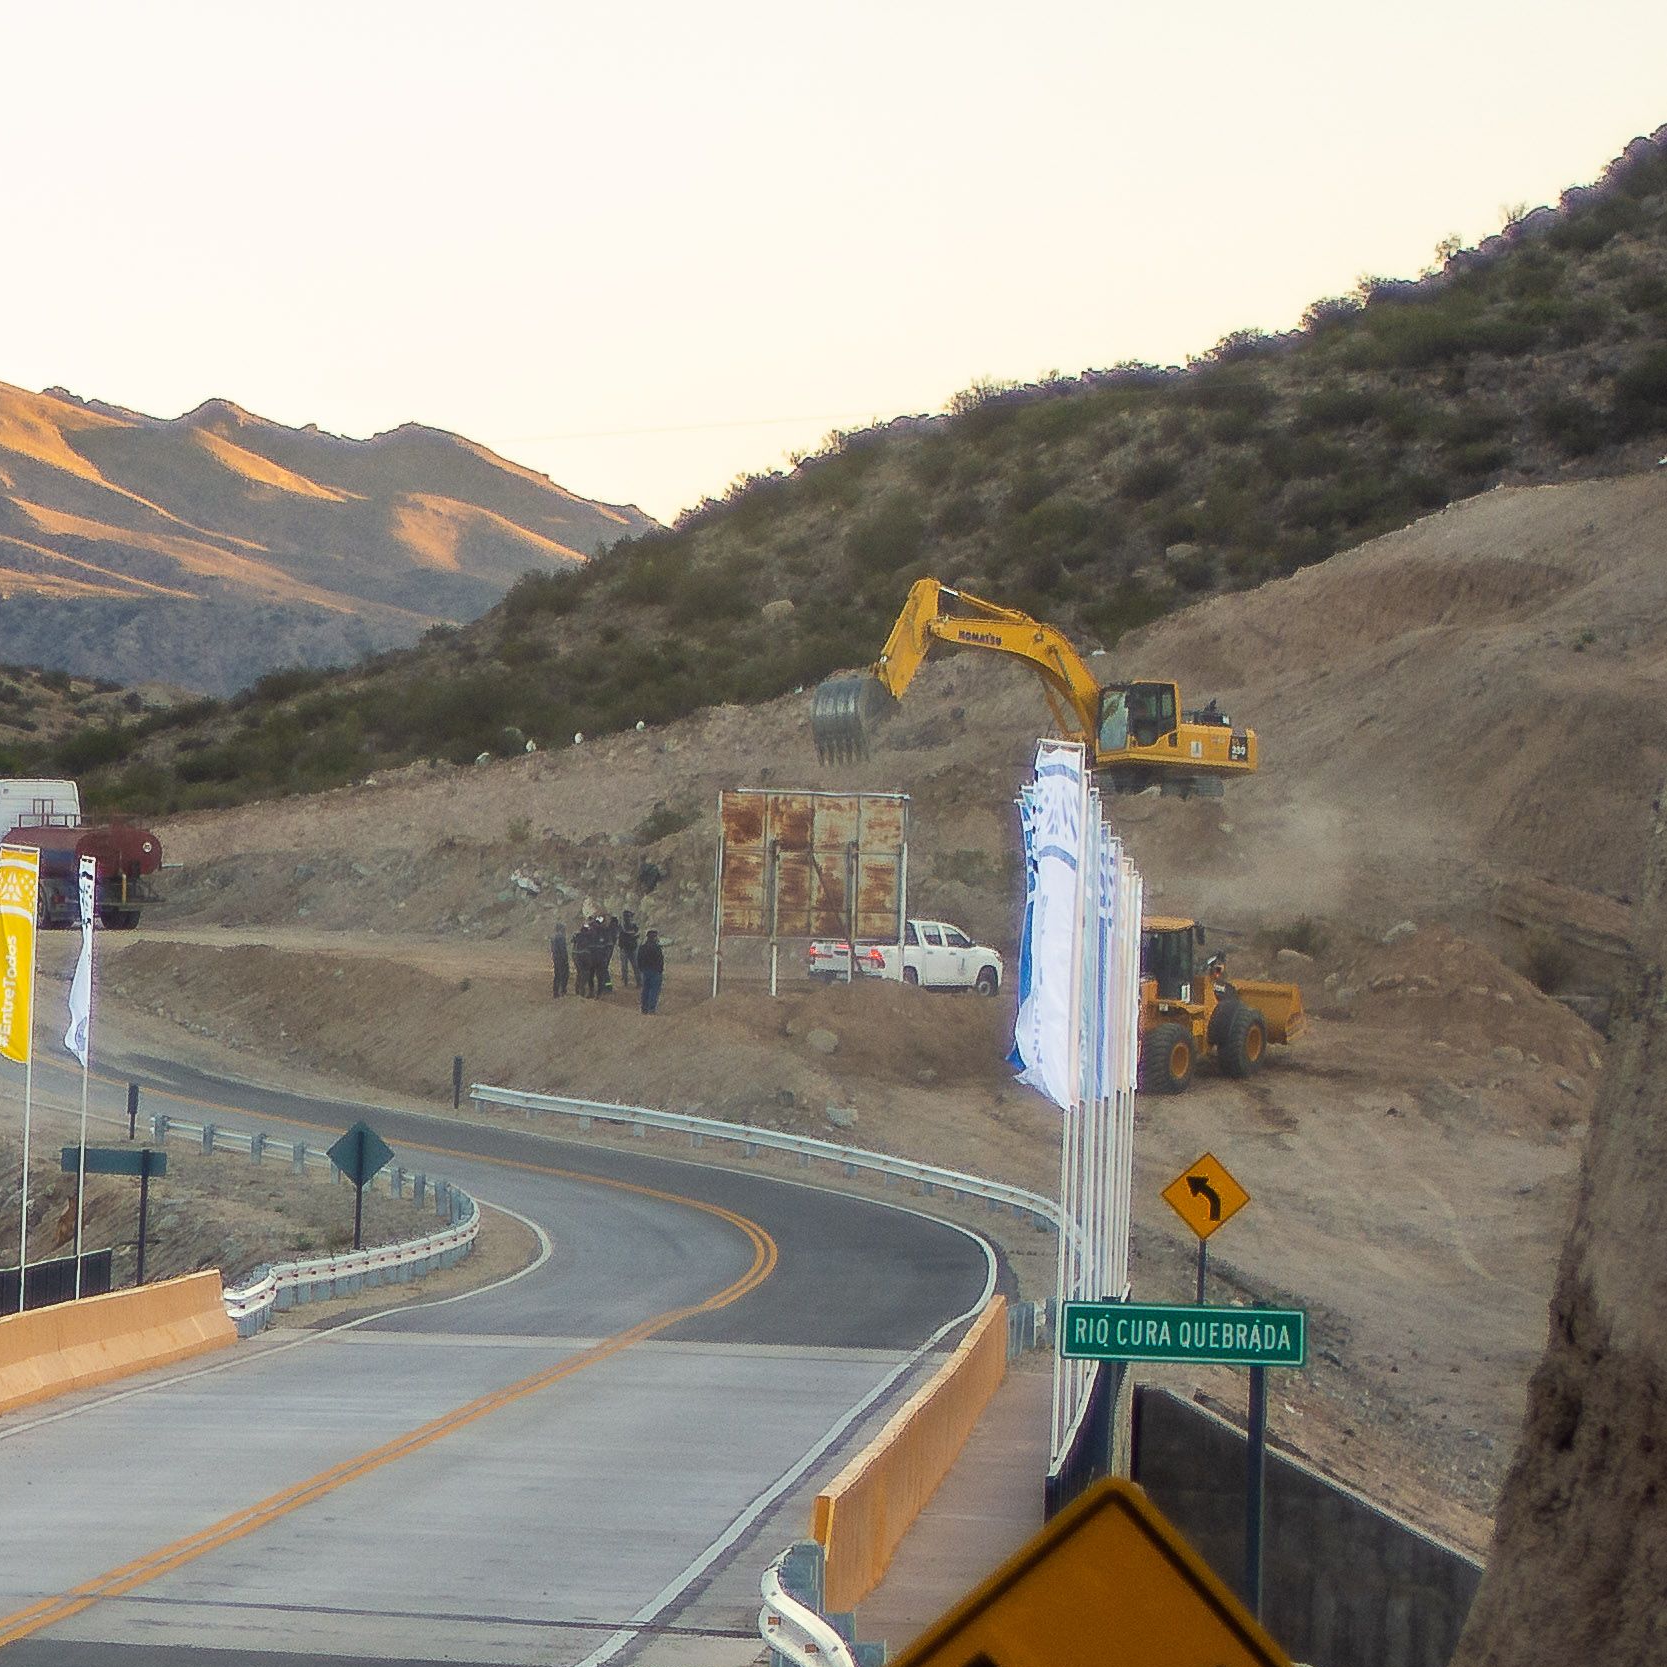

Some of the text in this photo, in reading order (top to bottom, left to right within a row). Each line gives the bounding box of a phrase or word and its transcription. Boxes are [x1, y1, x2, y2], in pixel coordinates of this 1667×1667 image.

[1074, 1317, 1291, 1351] RIO CURA QUEBRADA
